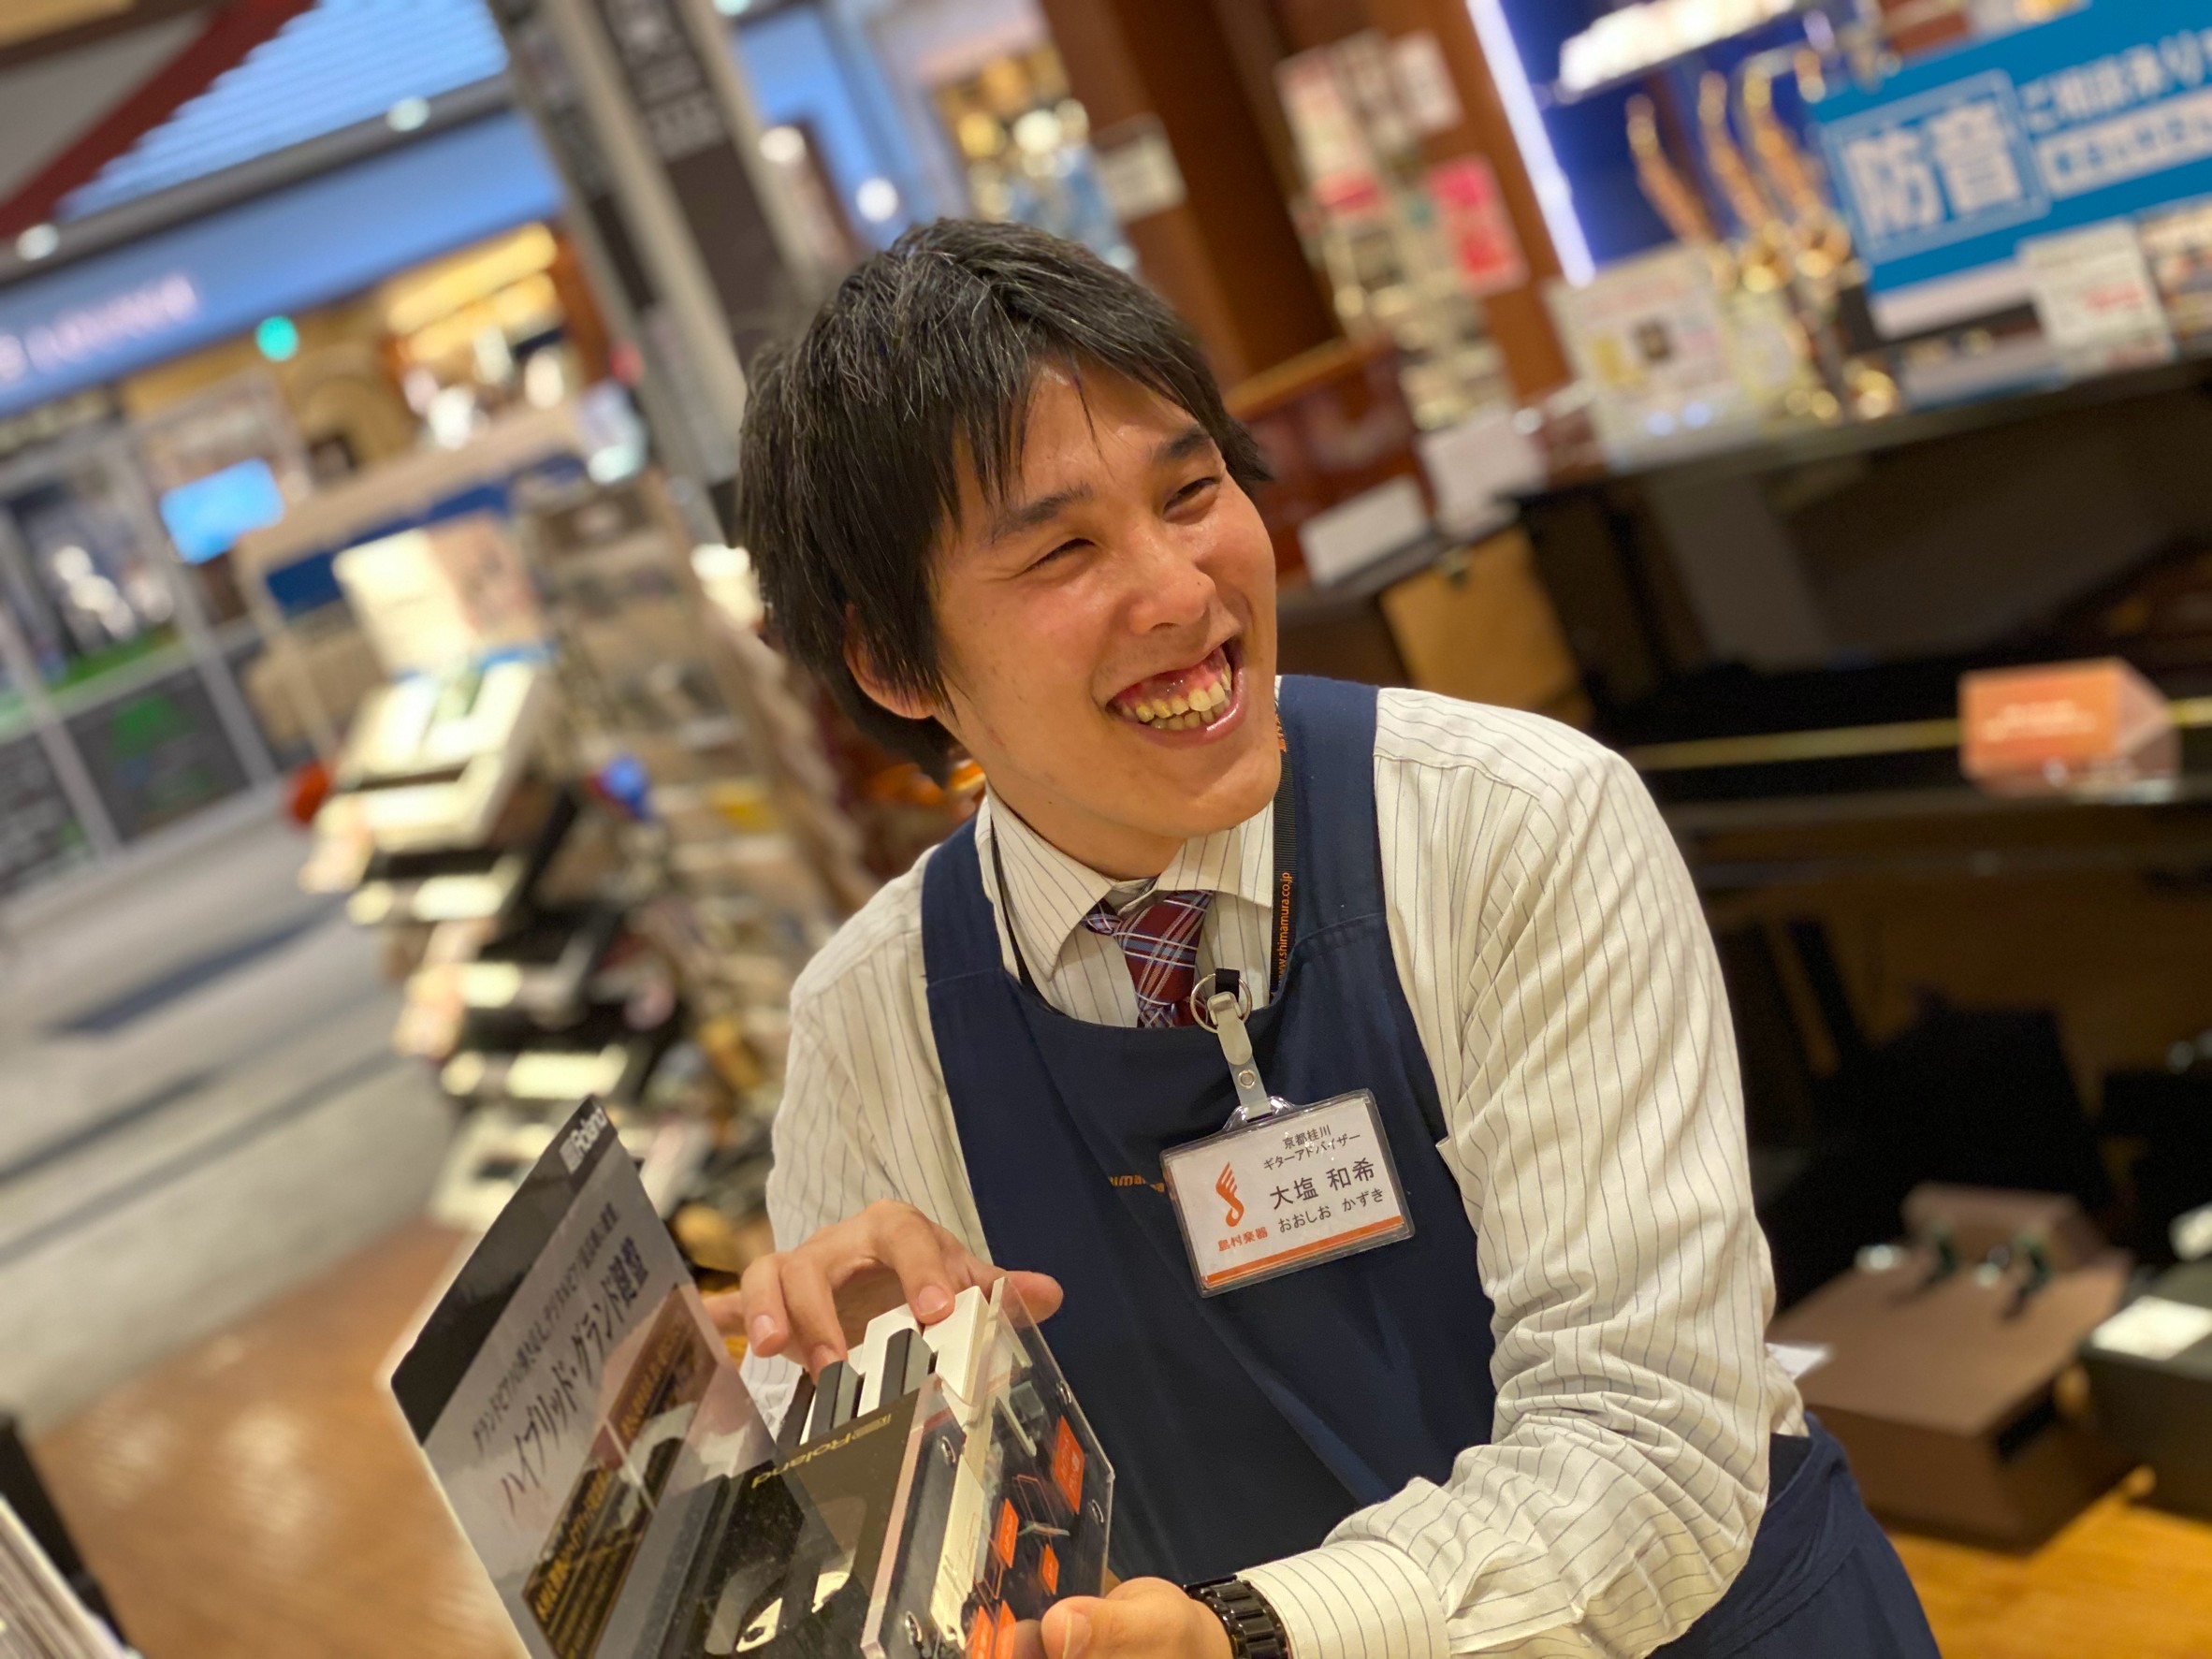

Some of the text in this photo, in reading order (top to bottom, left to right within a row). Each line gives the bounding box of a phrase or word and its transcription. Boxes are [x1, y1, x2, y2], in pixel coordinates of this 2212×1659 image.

[1277, 871, 1293, 988] w.shimamura.co.jp
[1263, 1131, 1361, 1171] ギターアドバイザー
[1282, 1124, 1332, 1150] 京都桂川
[1269, 1157, 1375, 1210] 大塩 和希
[1277, 1186, 1384, 1233] おおしお かずき
[751, 1432, 852, 1489] Roland
